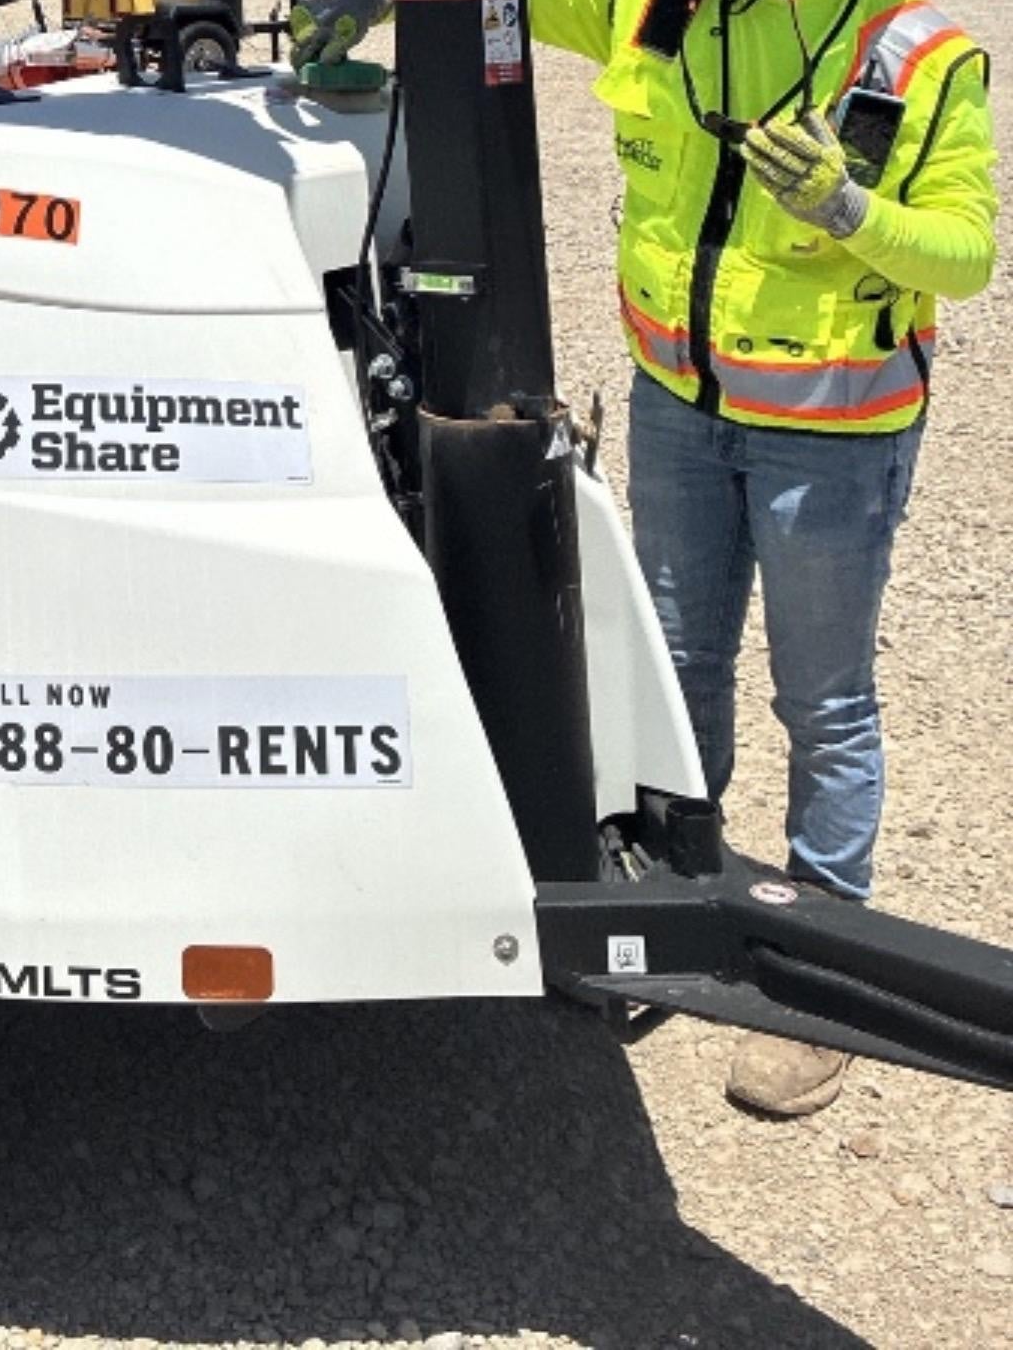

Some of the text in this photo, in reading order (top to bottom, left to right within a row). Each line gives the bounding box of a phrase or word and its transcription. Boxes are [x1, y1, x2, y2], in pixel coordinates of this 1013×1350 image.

[31, 383, 303, 433] Equipment
[31, 432, 181, 473] Share
[45, 683, 112, 709] NOW
